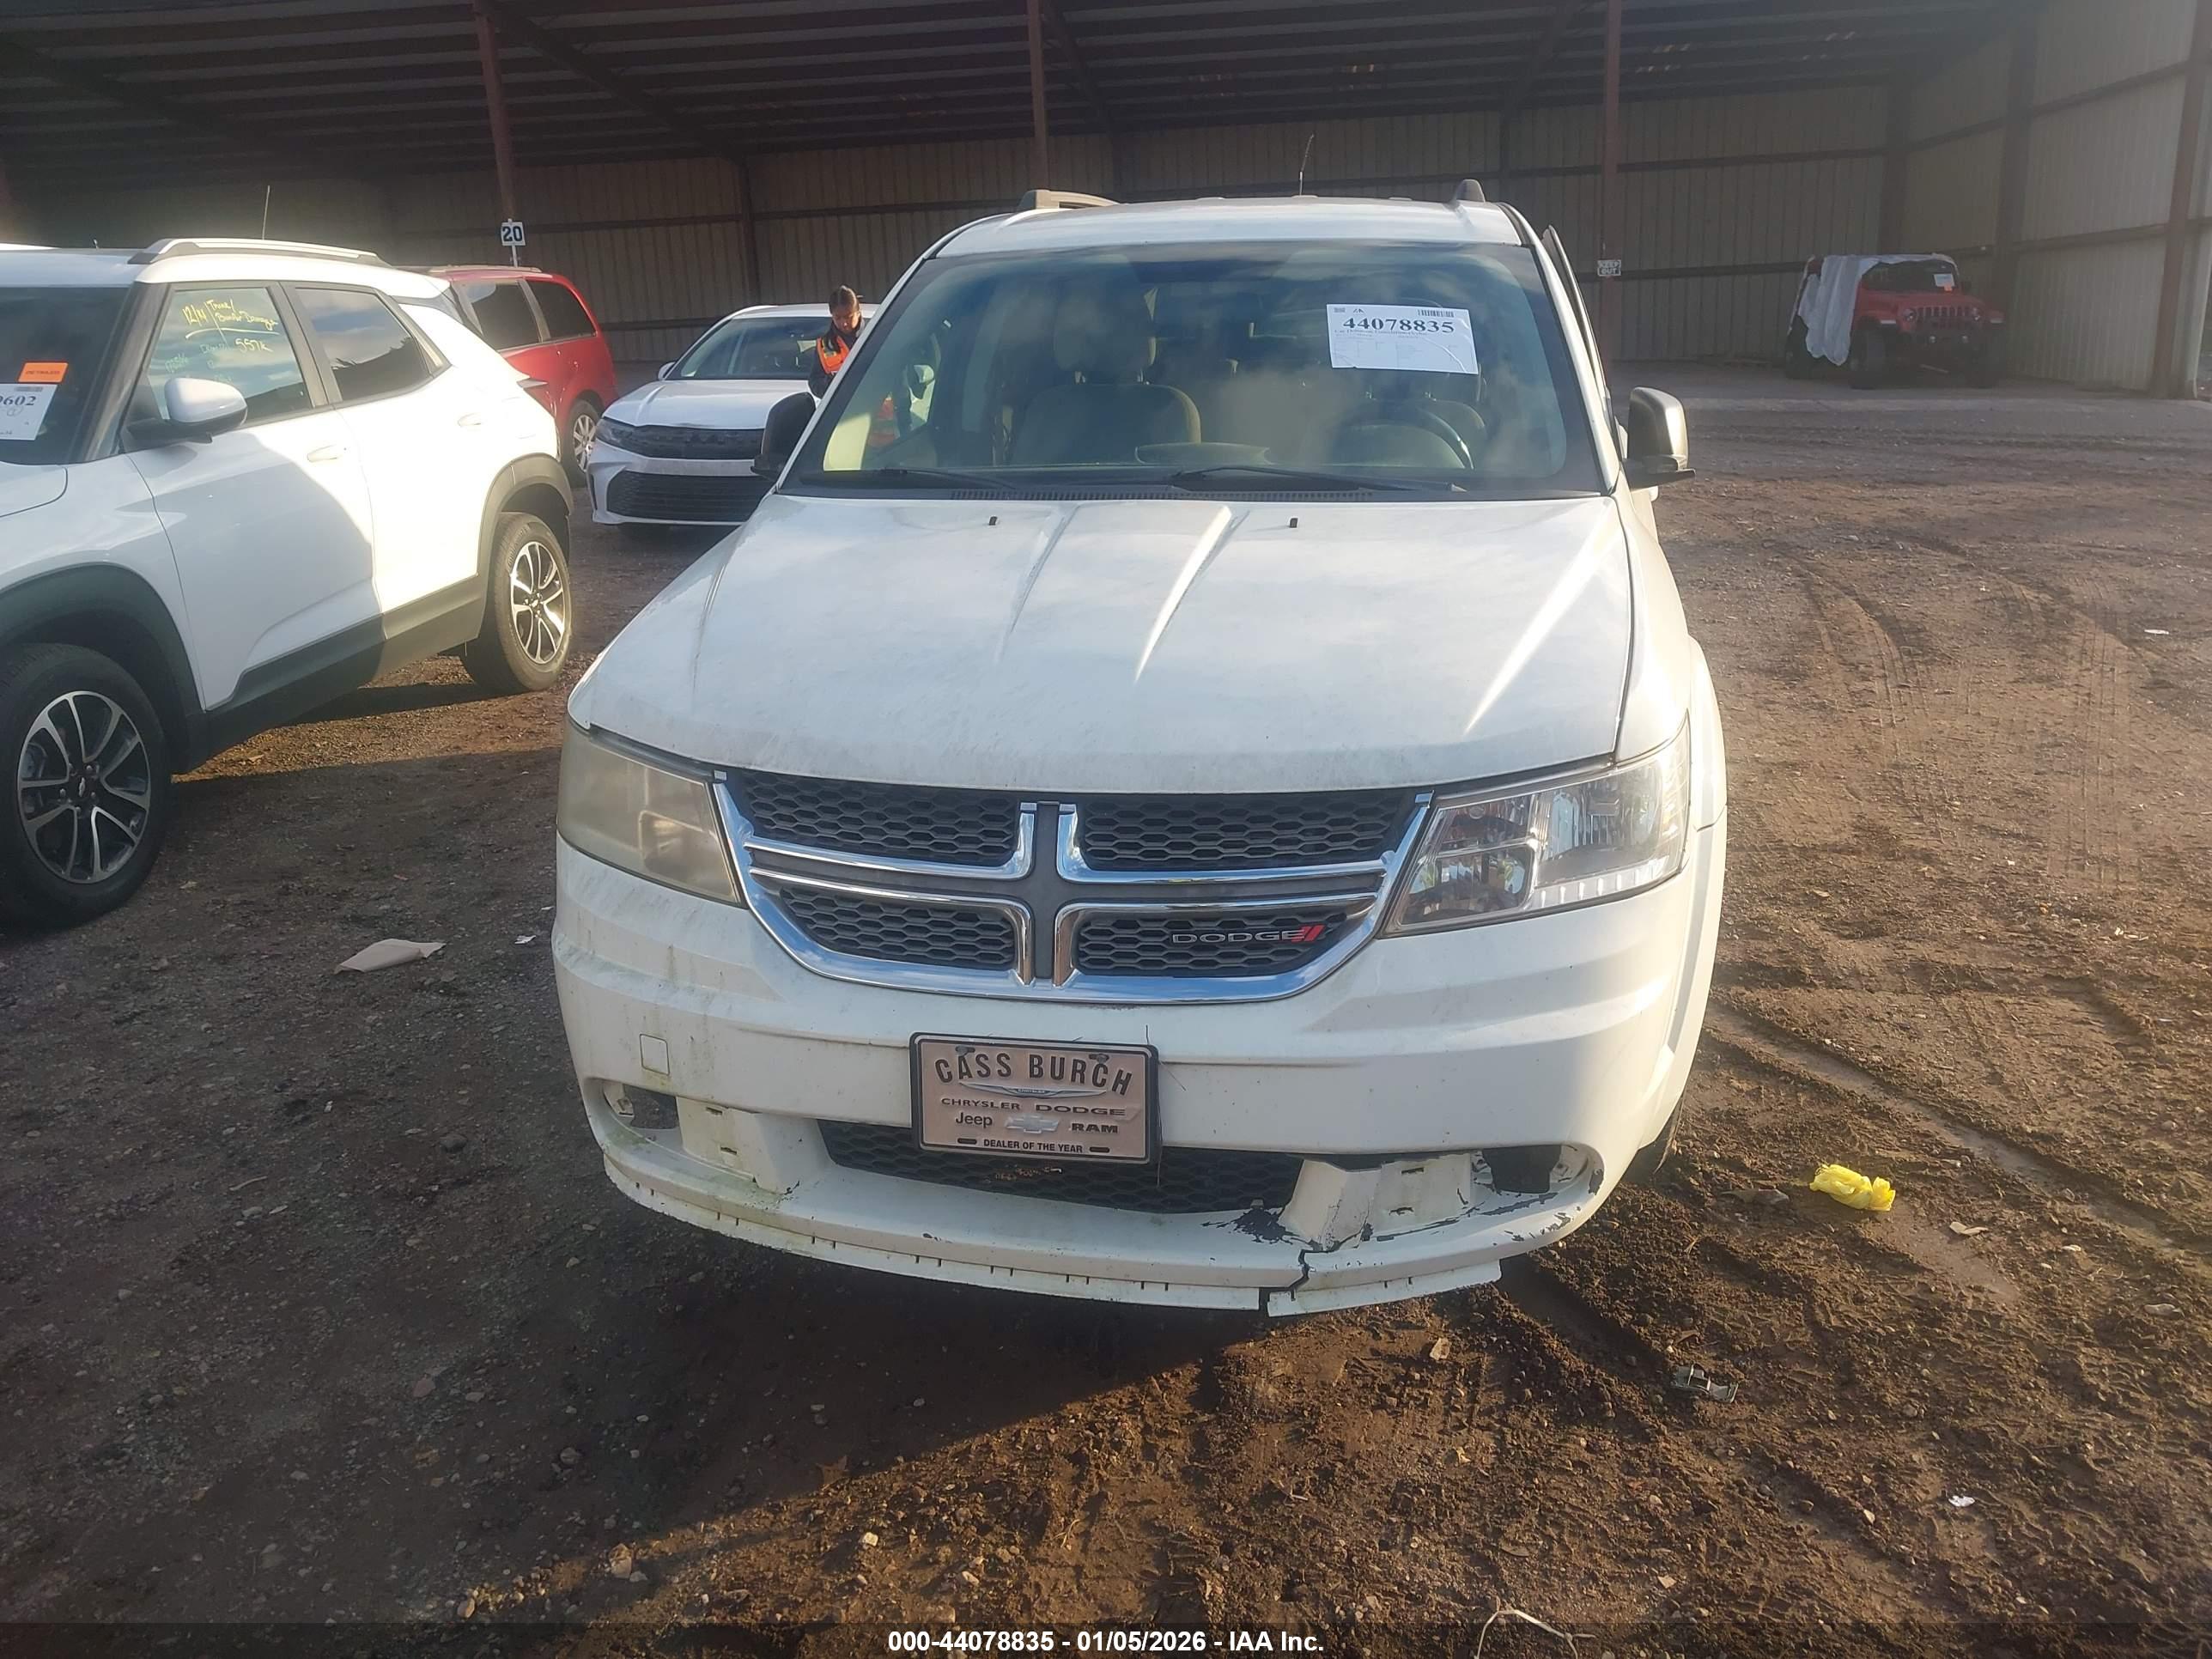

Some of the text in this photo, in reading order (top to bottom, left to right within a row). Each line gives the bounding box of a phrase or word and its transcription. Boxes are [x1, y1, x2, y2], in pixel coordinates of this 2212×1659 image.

[502, 226, 523, 241] 20
[1343, 318, 1455, 333] 44078835
[1172, 928, 1305, 944] DODGE
[934, 1053, 1133, 1096] CASS BURCH
[940, 1097, 1127, 1116] CHRYSLER DODGE
[955, 1112, 1119, 1133] Jeep RAM
[983, 1138, 1084, 1153] DEALER OF THE YEAR
